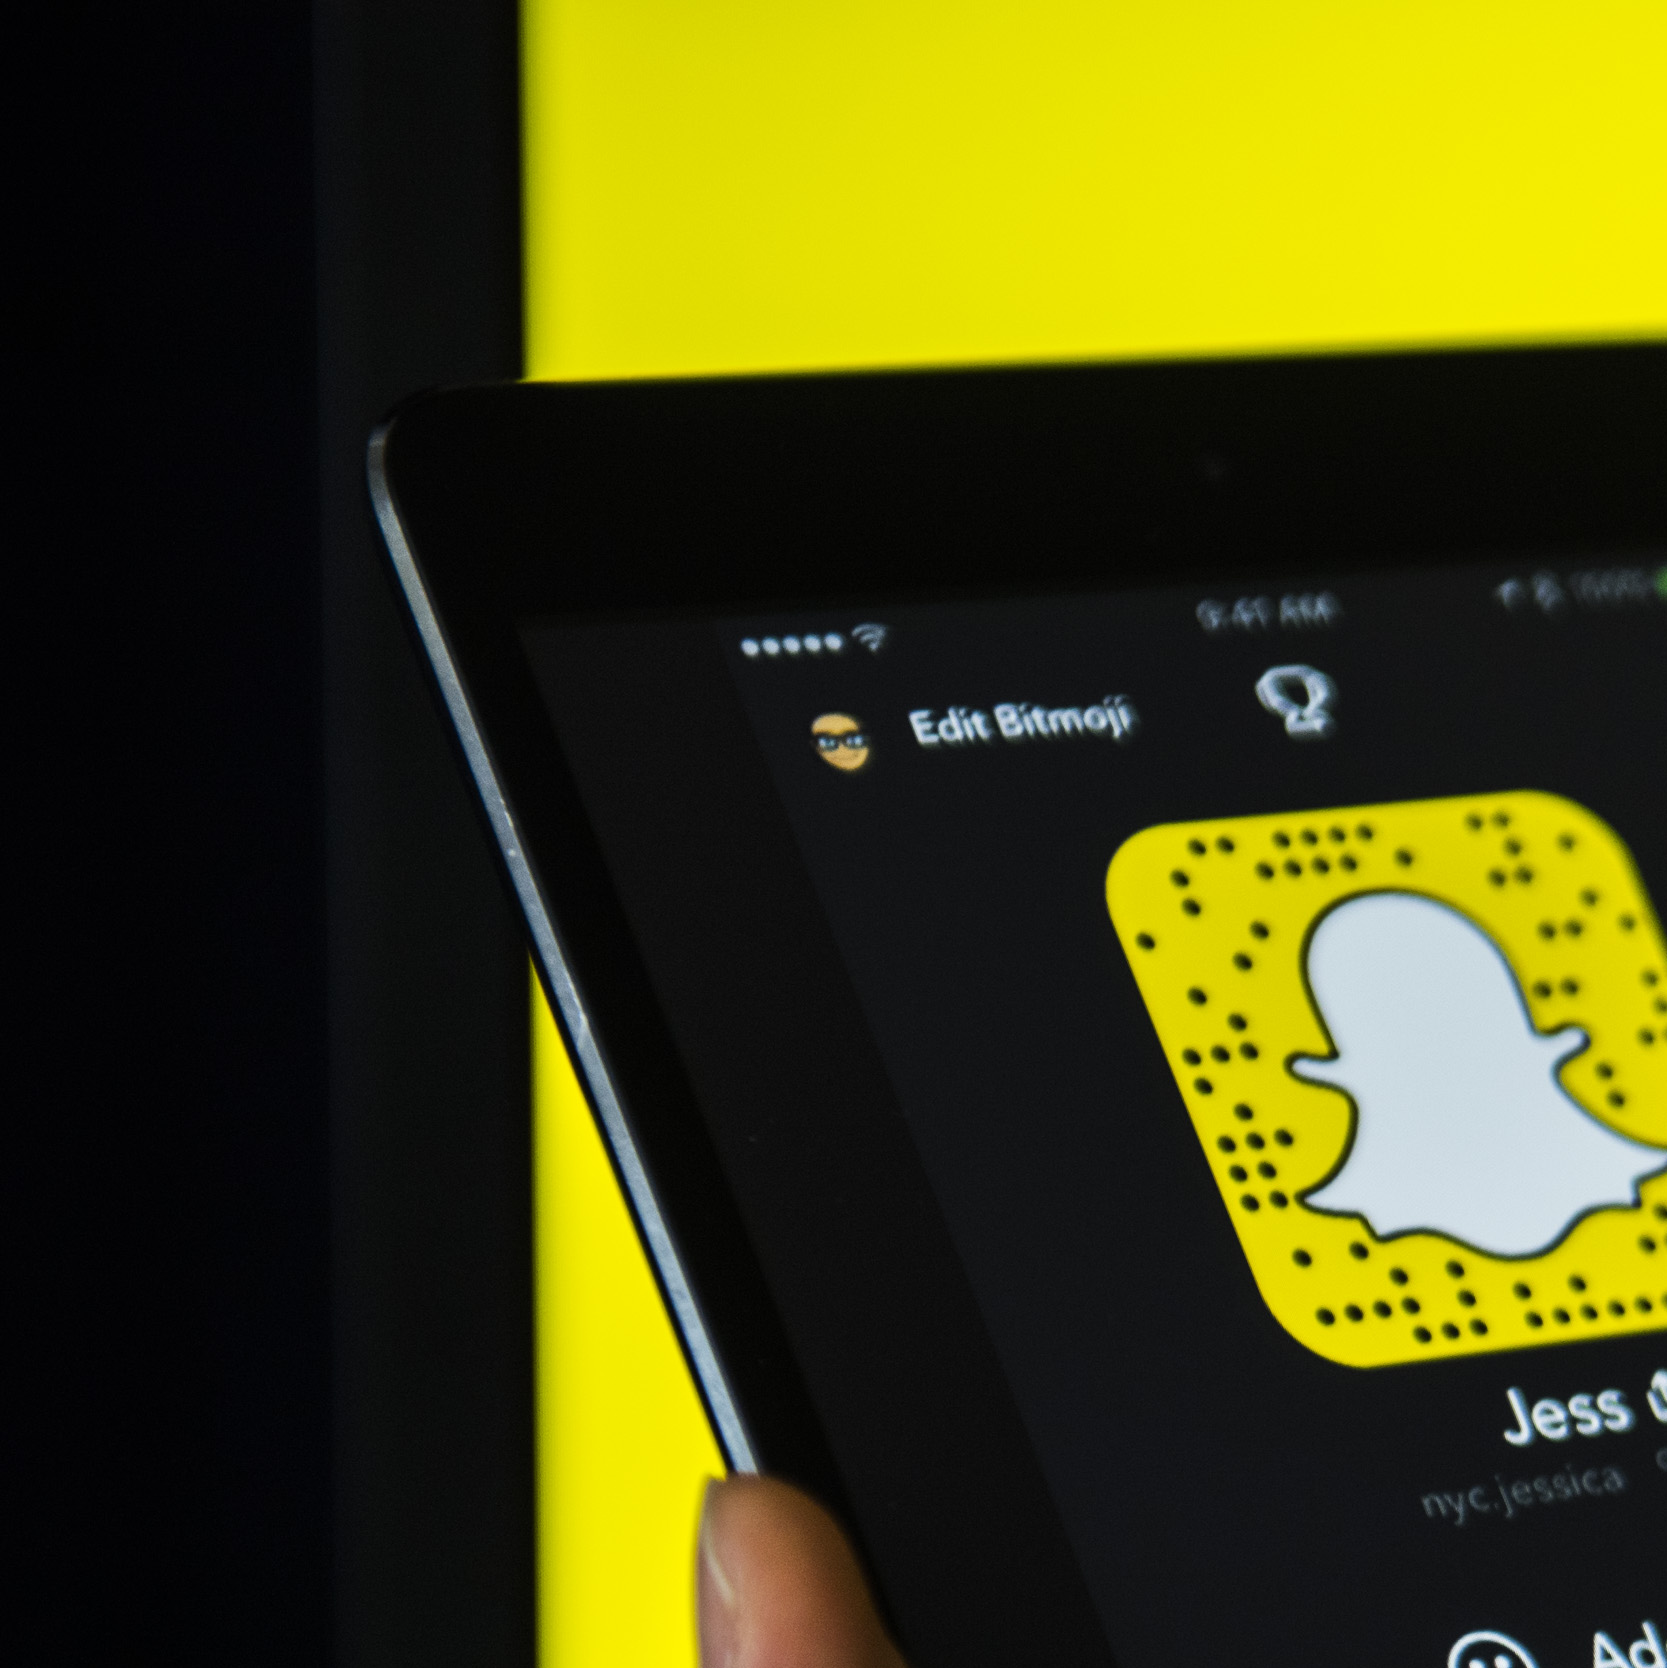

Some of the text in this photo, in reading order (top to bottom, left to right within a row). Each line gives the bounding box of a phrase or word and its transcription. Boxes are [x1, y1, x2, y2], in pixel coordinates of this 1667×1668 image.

[1279, 590, 1336, 627] AM
[908, 694, 1137, 747] Edit Bitmoji
[1503, 1386, 1634, 1446] Jess
[1421, 1463, 1627, 1527] nyc.jessica
